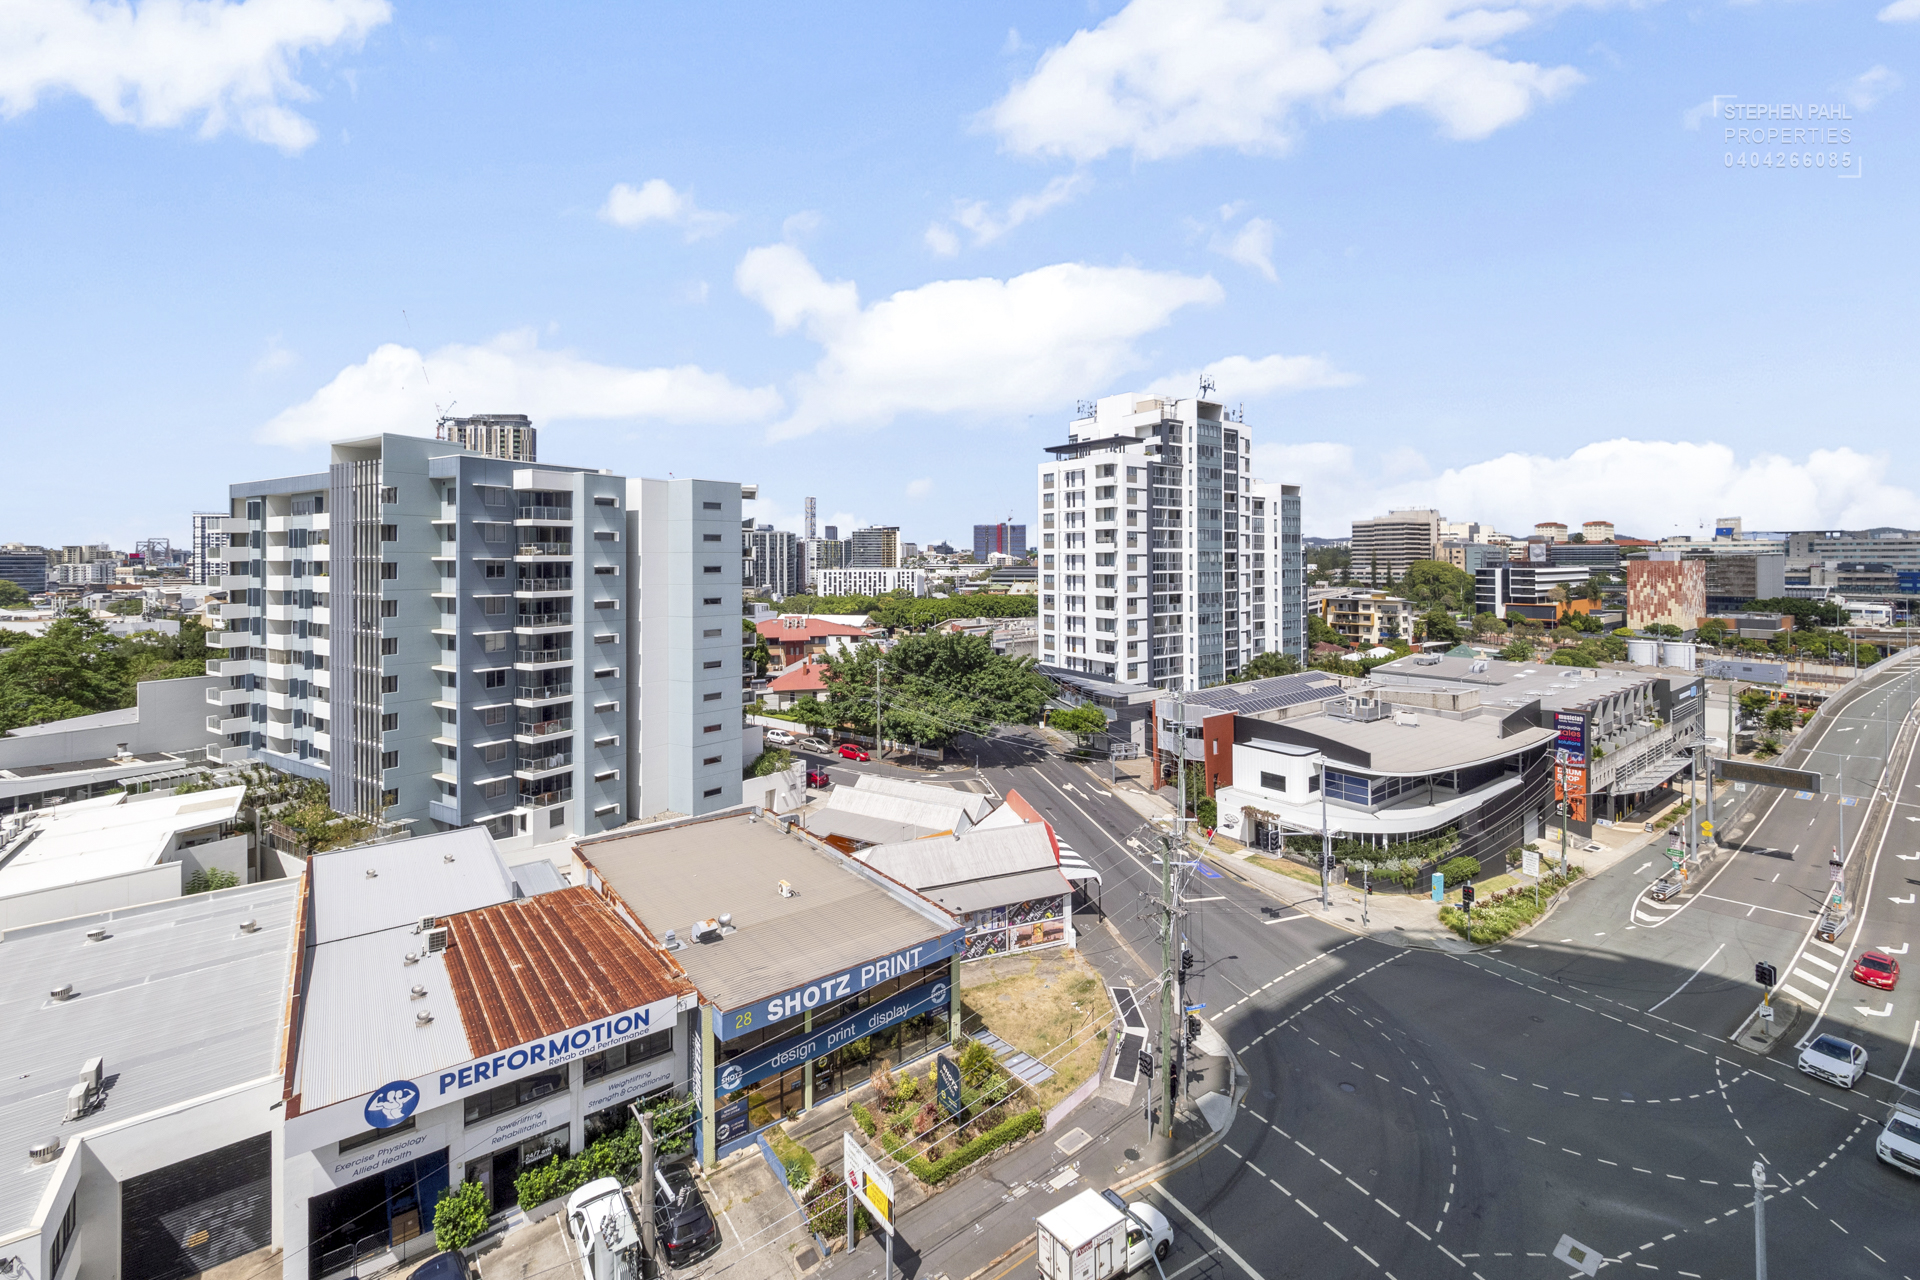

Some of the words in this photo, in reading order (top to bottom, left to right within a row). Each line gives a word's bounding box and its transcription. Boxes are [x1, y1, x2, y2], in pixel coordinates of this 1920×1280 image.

[735, 1011, 752, 1029] 28
[767, 973, 851, 1021] SHOTZ
[861, 946, 923, 987] PRINT
[439, 1008, 650, 1095] PERFORMOTION
[549, 1052, 577, 1067] Rehab
[578, 1045, 596, 1056] and
[597, 1027, 650, 1050] Performance
[771, 1040, 816, 1068] design
[827, 1023, 856, 1048] print
[868, 1003, 910, 1028] display
[588, 1092, 620, 1108] Strength
[620, 1088, 626, 1097] &
[626, 1072, 671, 1094] Conditioning
[608, 1071, 652, 1091] Weightlifting
[491, 1119, 547, 1145] Rehabilitation
[495, 1111, 542, 1133] Powerlifting
[334, 1153, 375, 1173] Exercise
[377, 1134, 428, 1157] Physiology
[352, 1161, 379, 1177] Allied
[381, 1150, 412, 1166] Health
